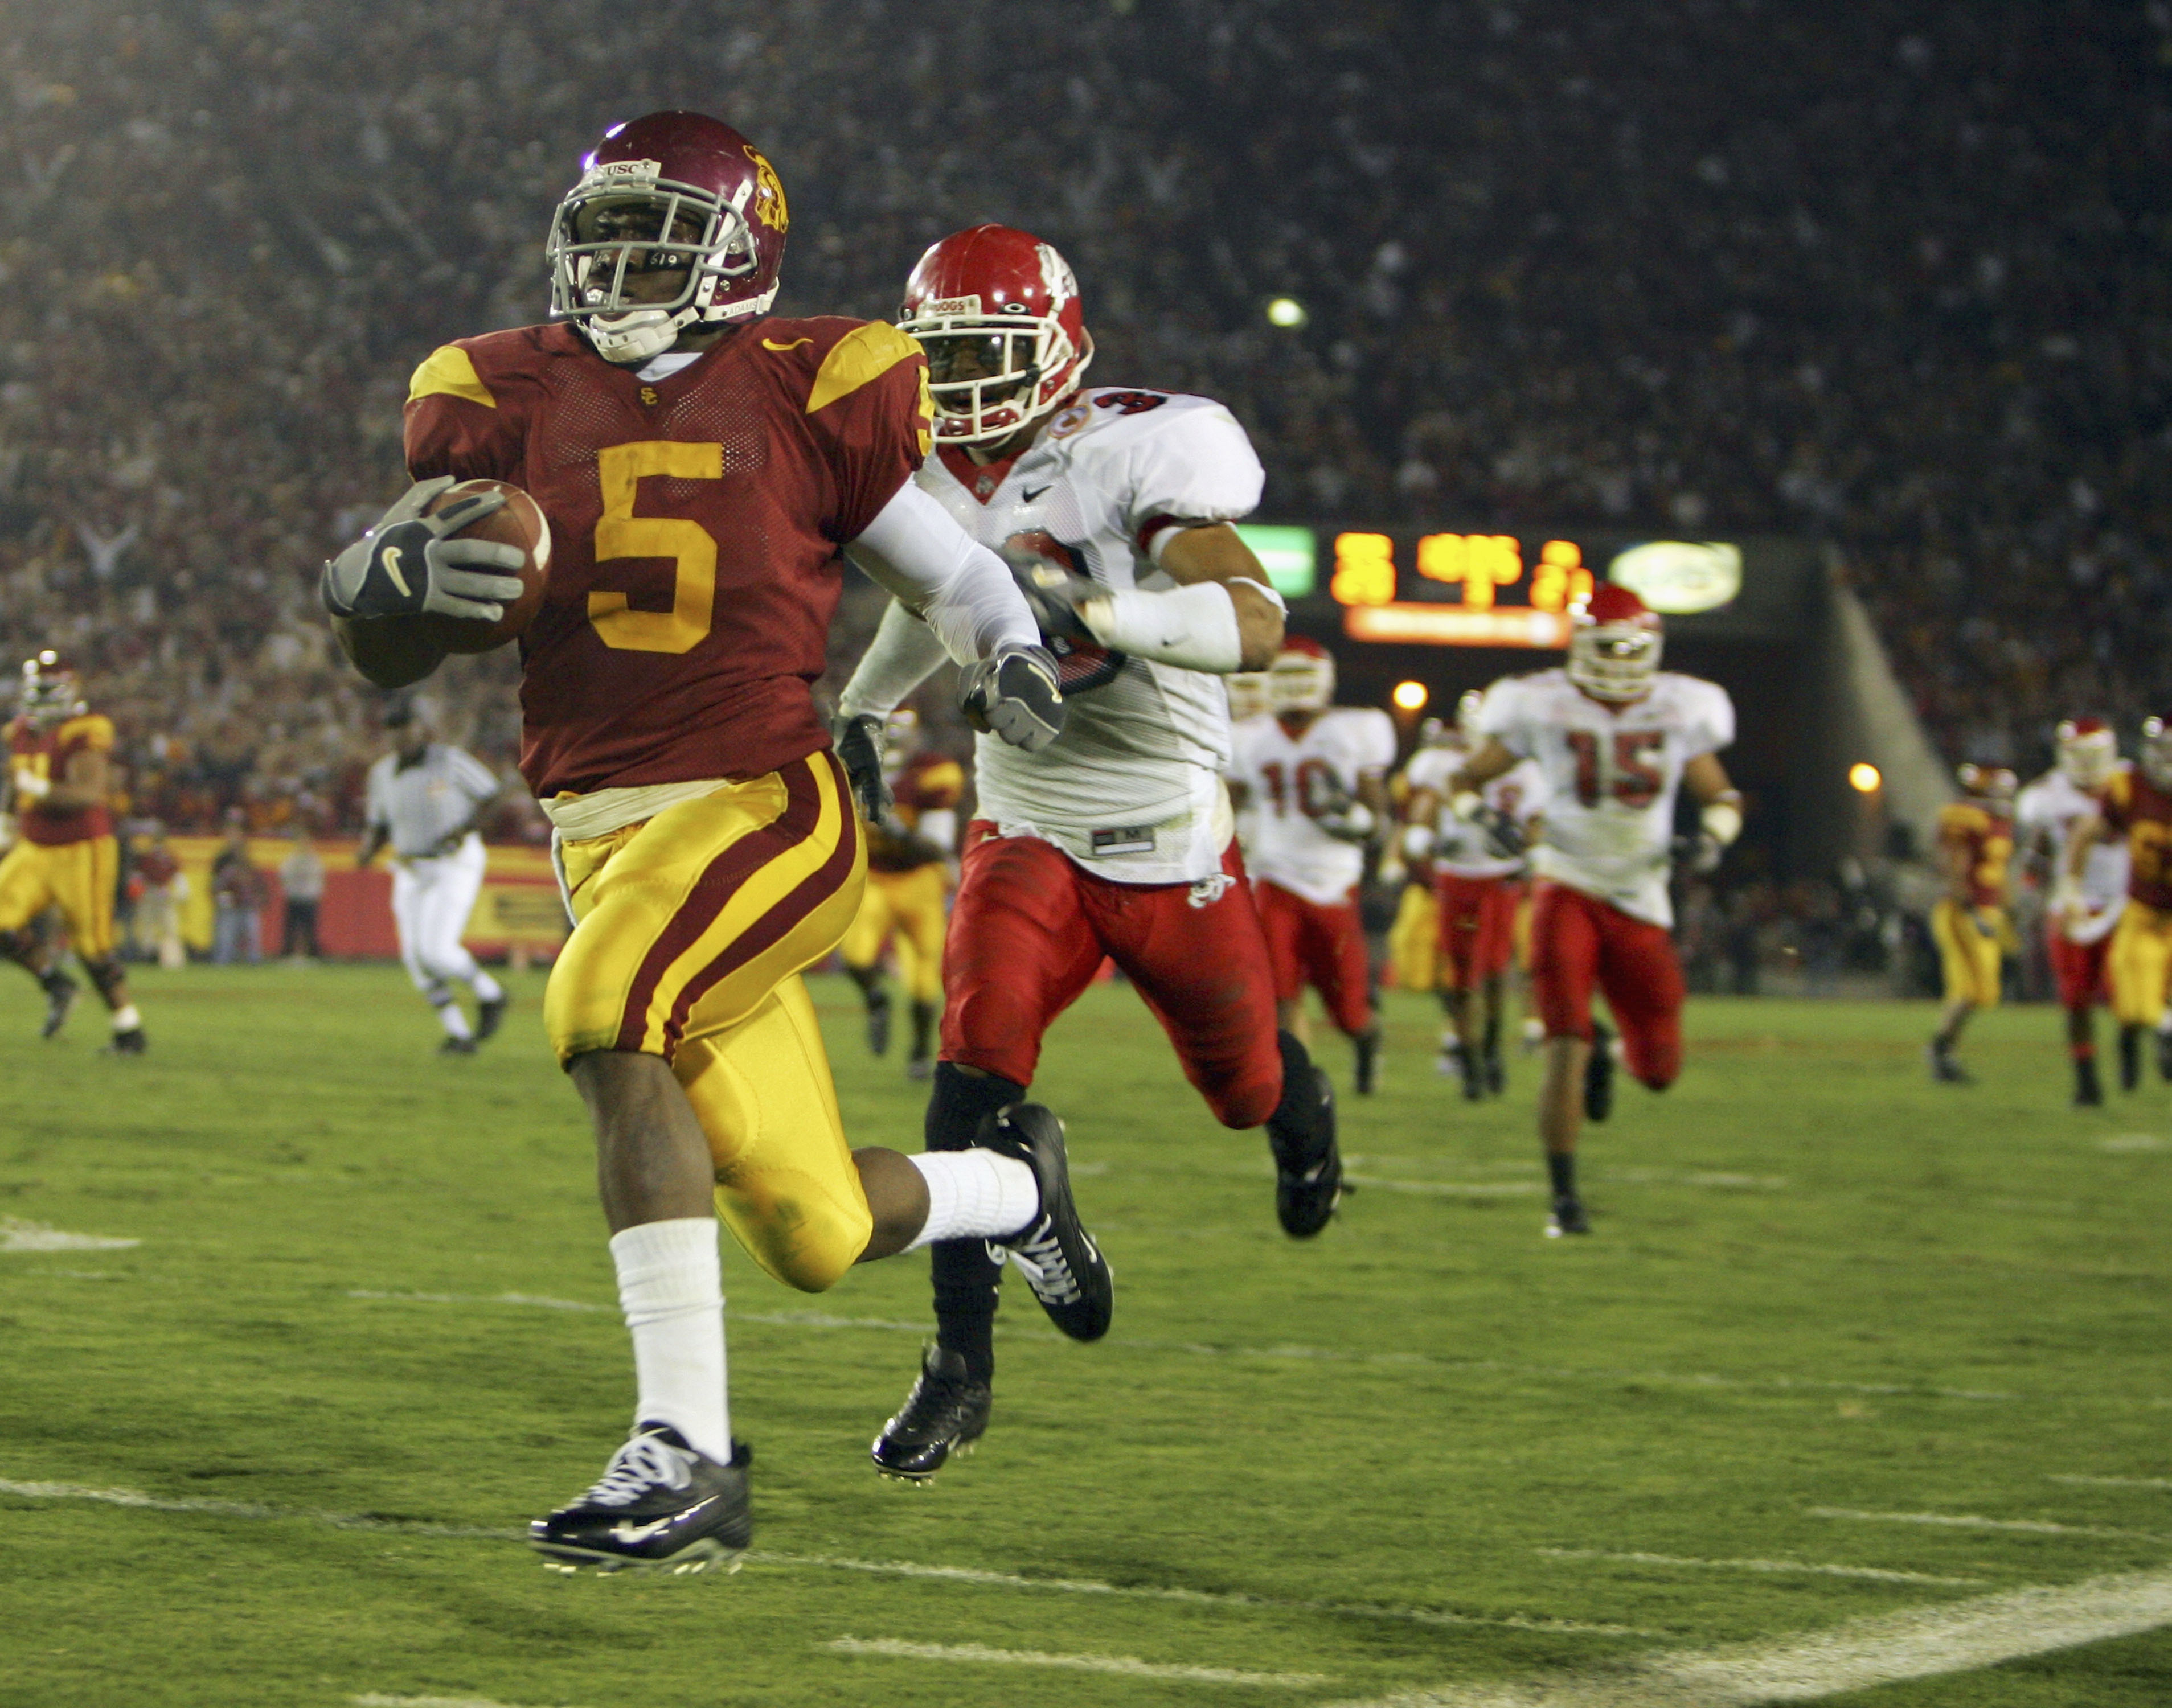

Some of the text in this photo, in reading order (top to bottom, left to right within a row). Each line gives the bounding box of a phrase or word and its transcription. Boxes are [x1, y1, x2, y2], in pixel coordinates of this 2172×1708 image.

[608, 164, 638, 175] USC
[587, 440, 722, 655] 5
[1260, 758, 1342, 819] 10
[1565, 729, 1664, 810] 15
